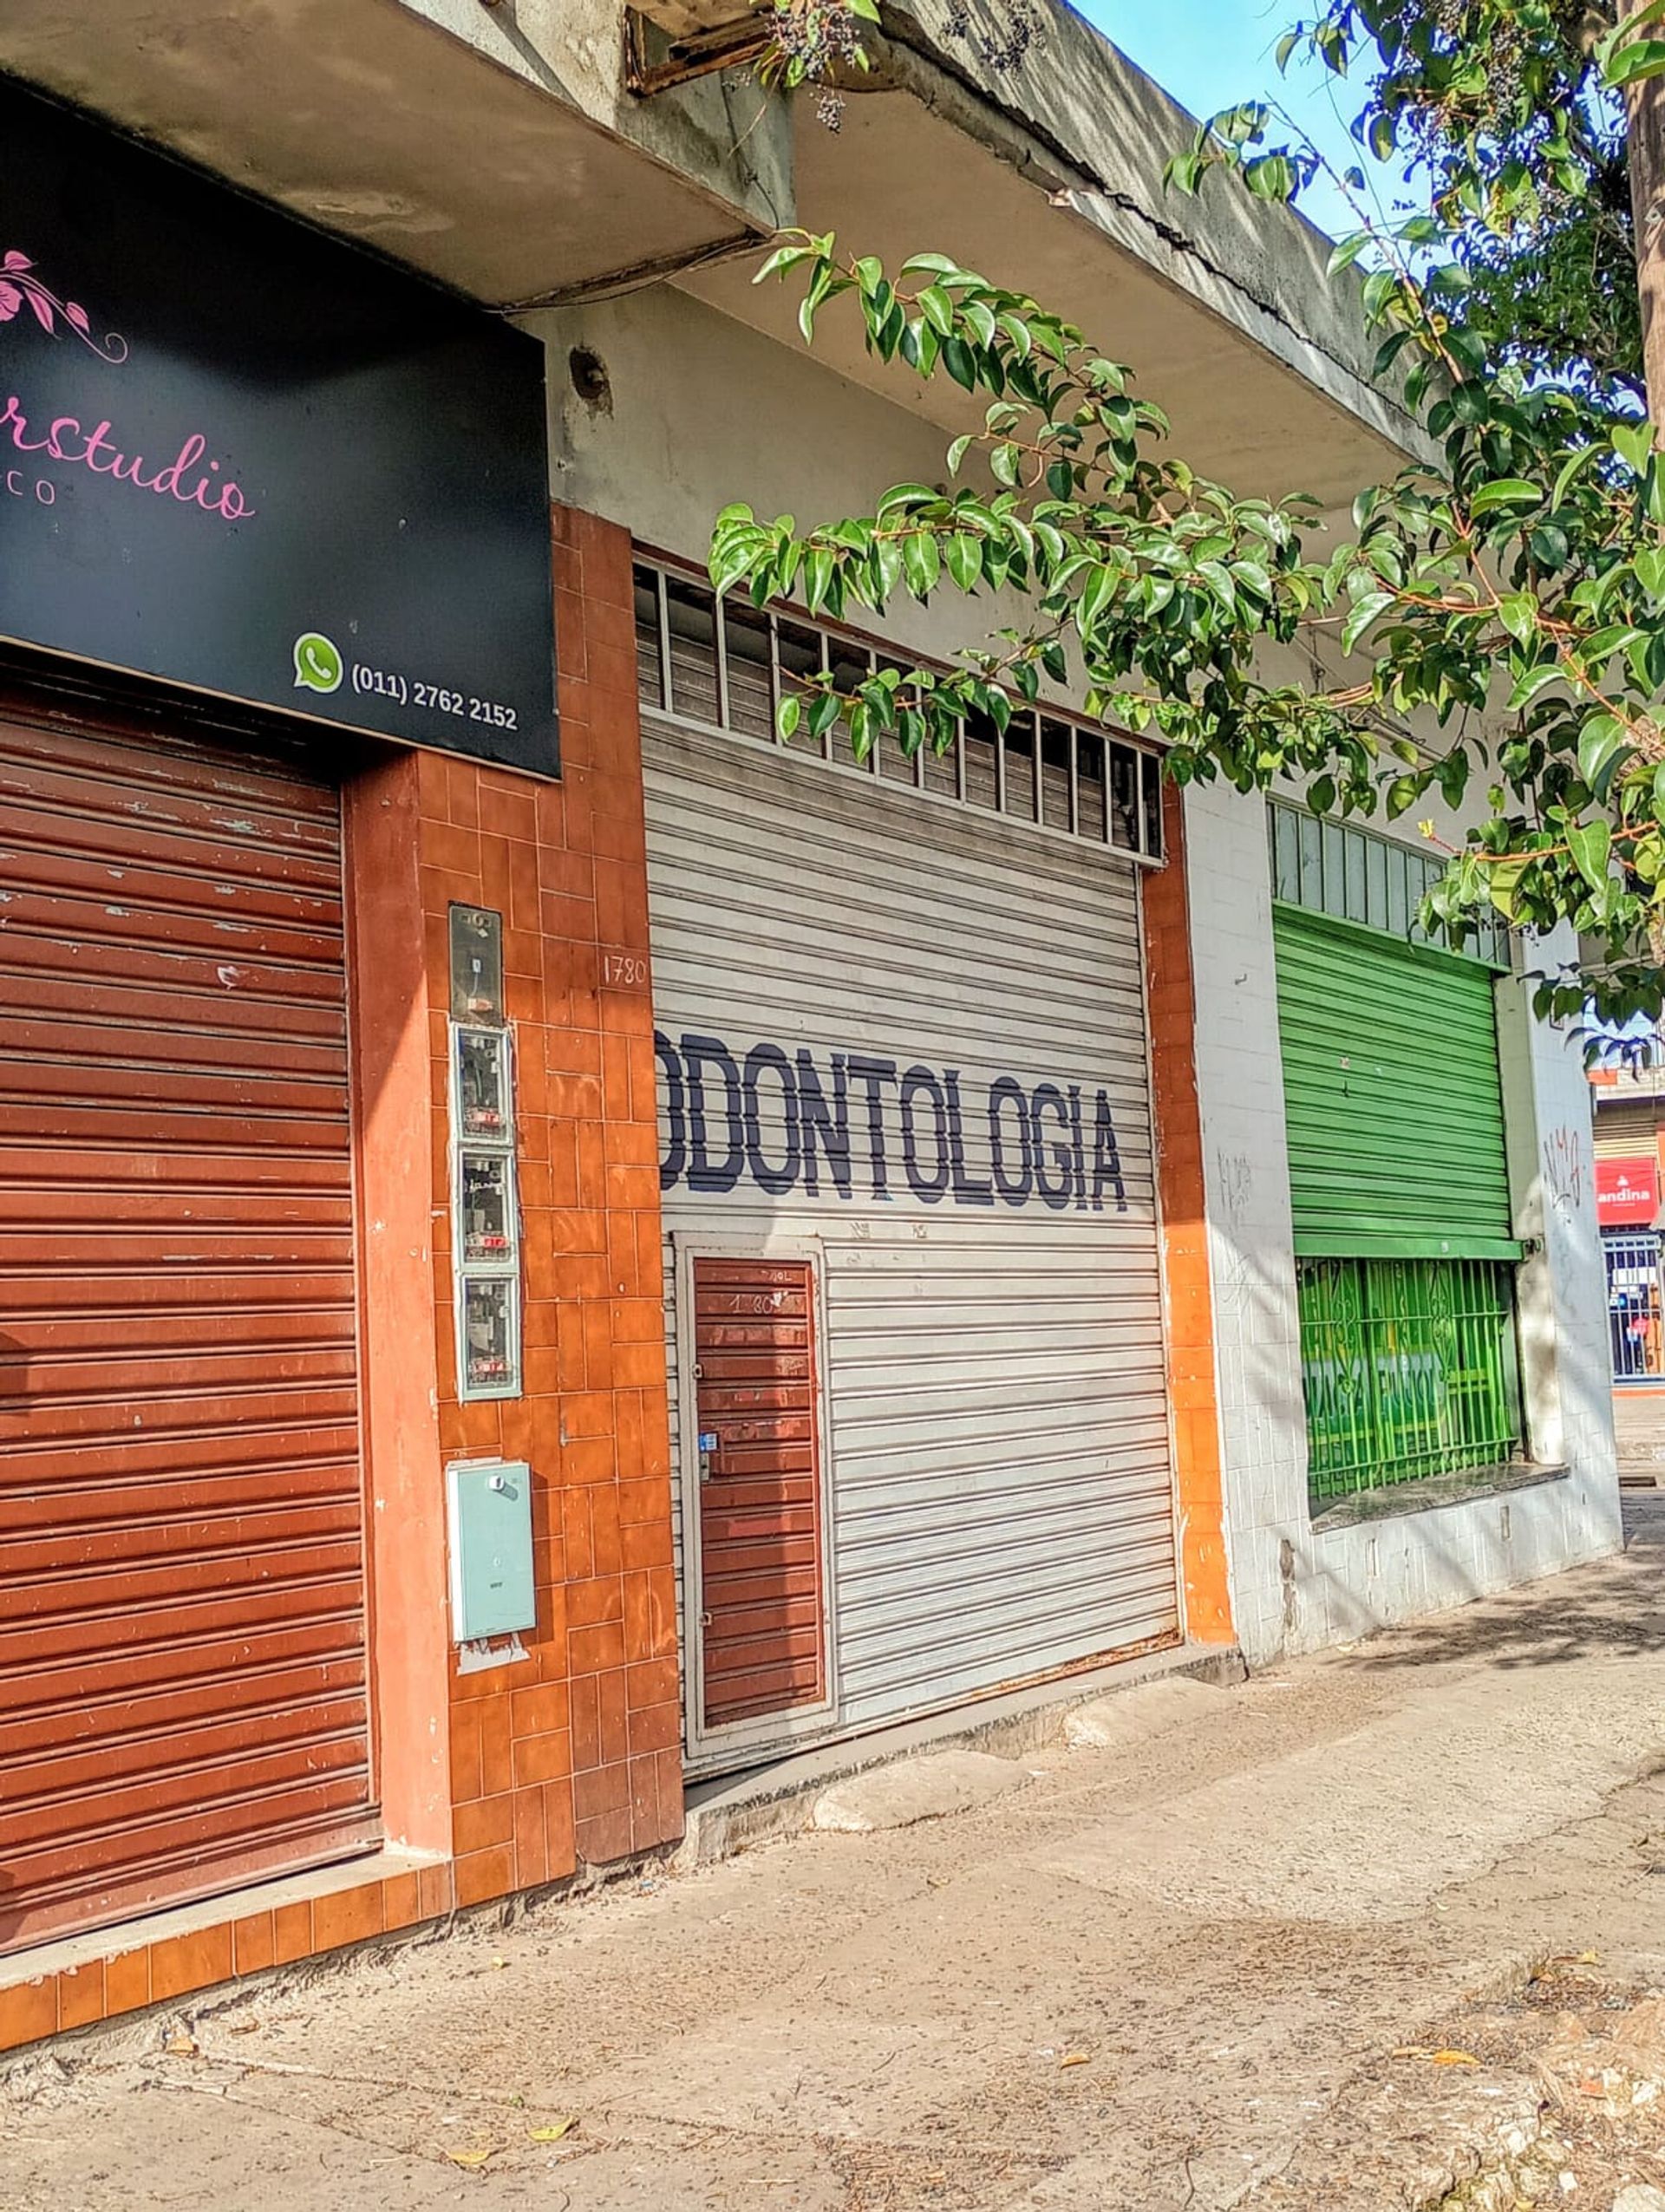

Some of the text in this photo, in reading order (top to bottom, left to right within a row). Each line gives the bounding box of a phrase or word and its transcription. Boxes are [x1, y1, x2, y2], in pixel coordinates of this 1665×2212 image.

[352, 663, 519, 730] (011) 2762 2152
[604, 955, 646, 985] 1780
[1597, 1187, 1651, 1204] andina
